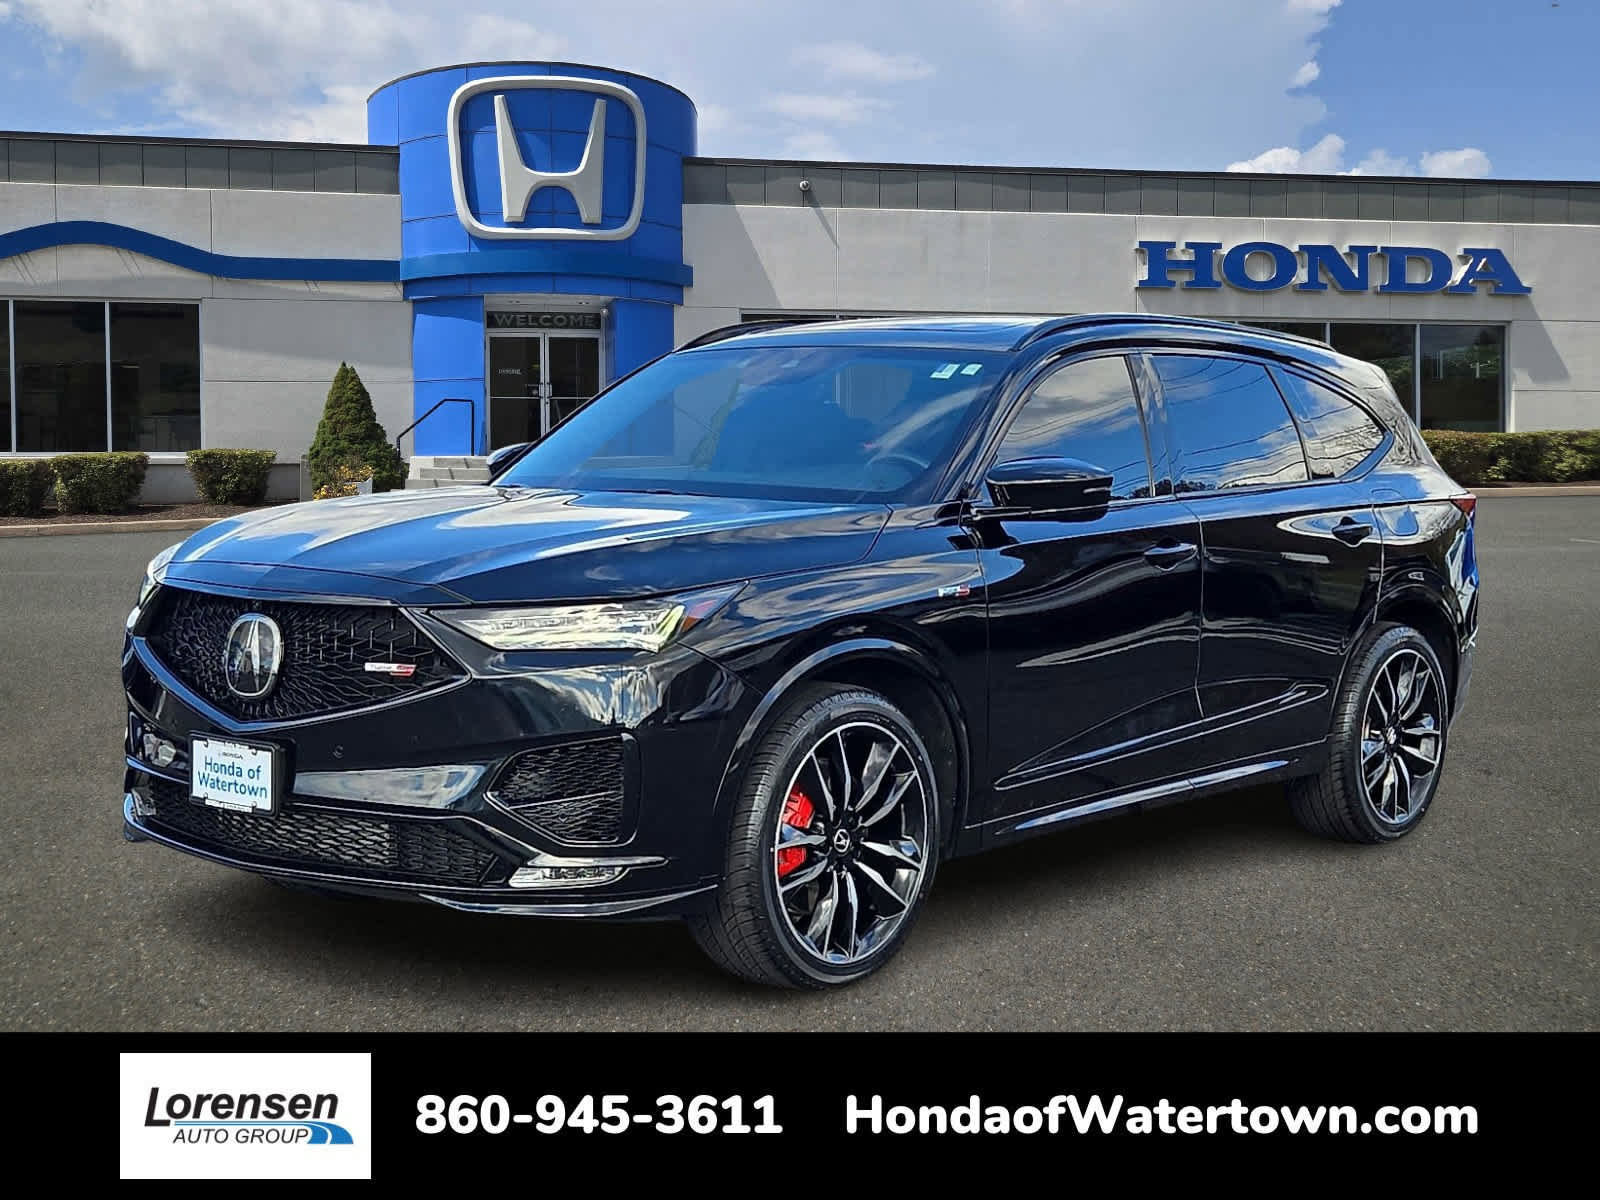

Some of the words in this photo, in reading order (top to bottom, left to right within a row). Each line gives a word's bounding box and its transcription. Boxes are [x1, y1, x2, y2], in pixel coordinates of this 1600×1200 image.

[1136, 240, 1532, 296] HONDA
[494, 314, 595, 327] WELCOME
[204, 755, 243, 777] Honda
[247, 765, 262, 780] of
[198, 770, 268, 799] Watertown
